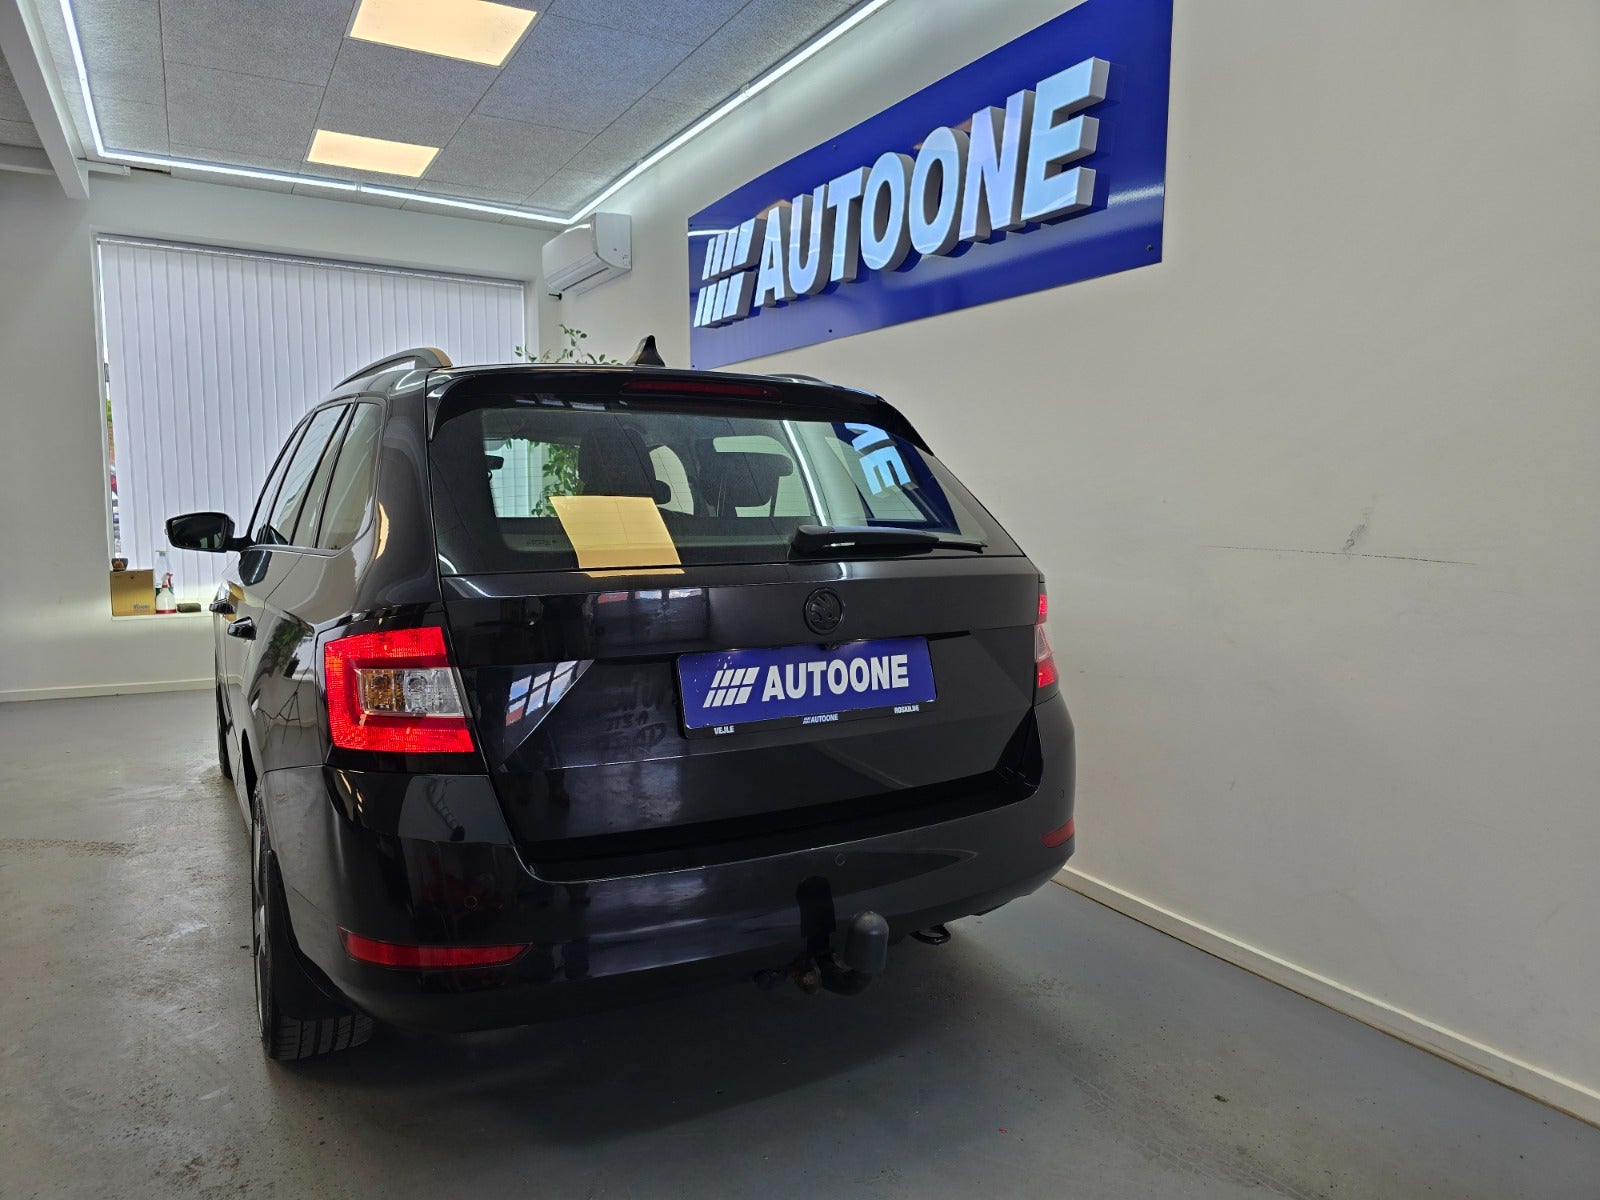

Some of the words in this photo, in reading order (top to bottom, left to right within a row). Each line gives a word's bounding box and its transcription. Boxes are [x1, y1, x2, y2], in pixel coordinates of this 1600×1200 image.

[754, 57, 1108, 307] AUTOONE
[762, 654, 909, 702] AUTOONE
[714, 725, 735, 735] VEJLE
[810, 713, 839, 724] AUTOONE
